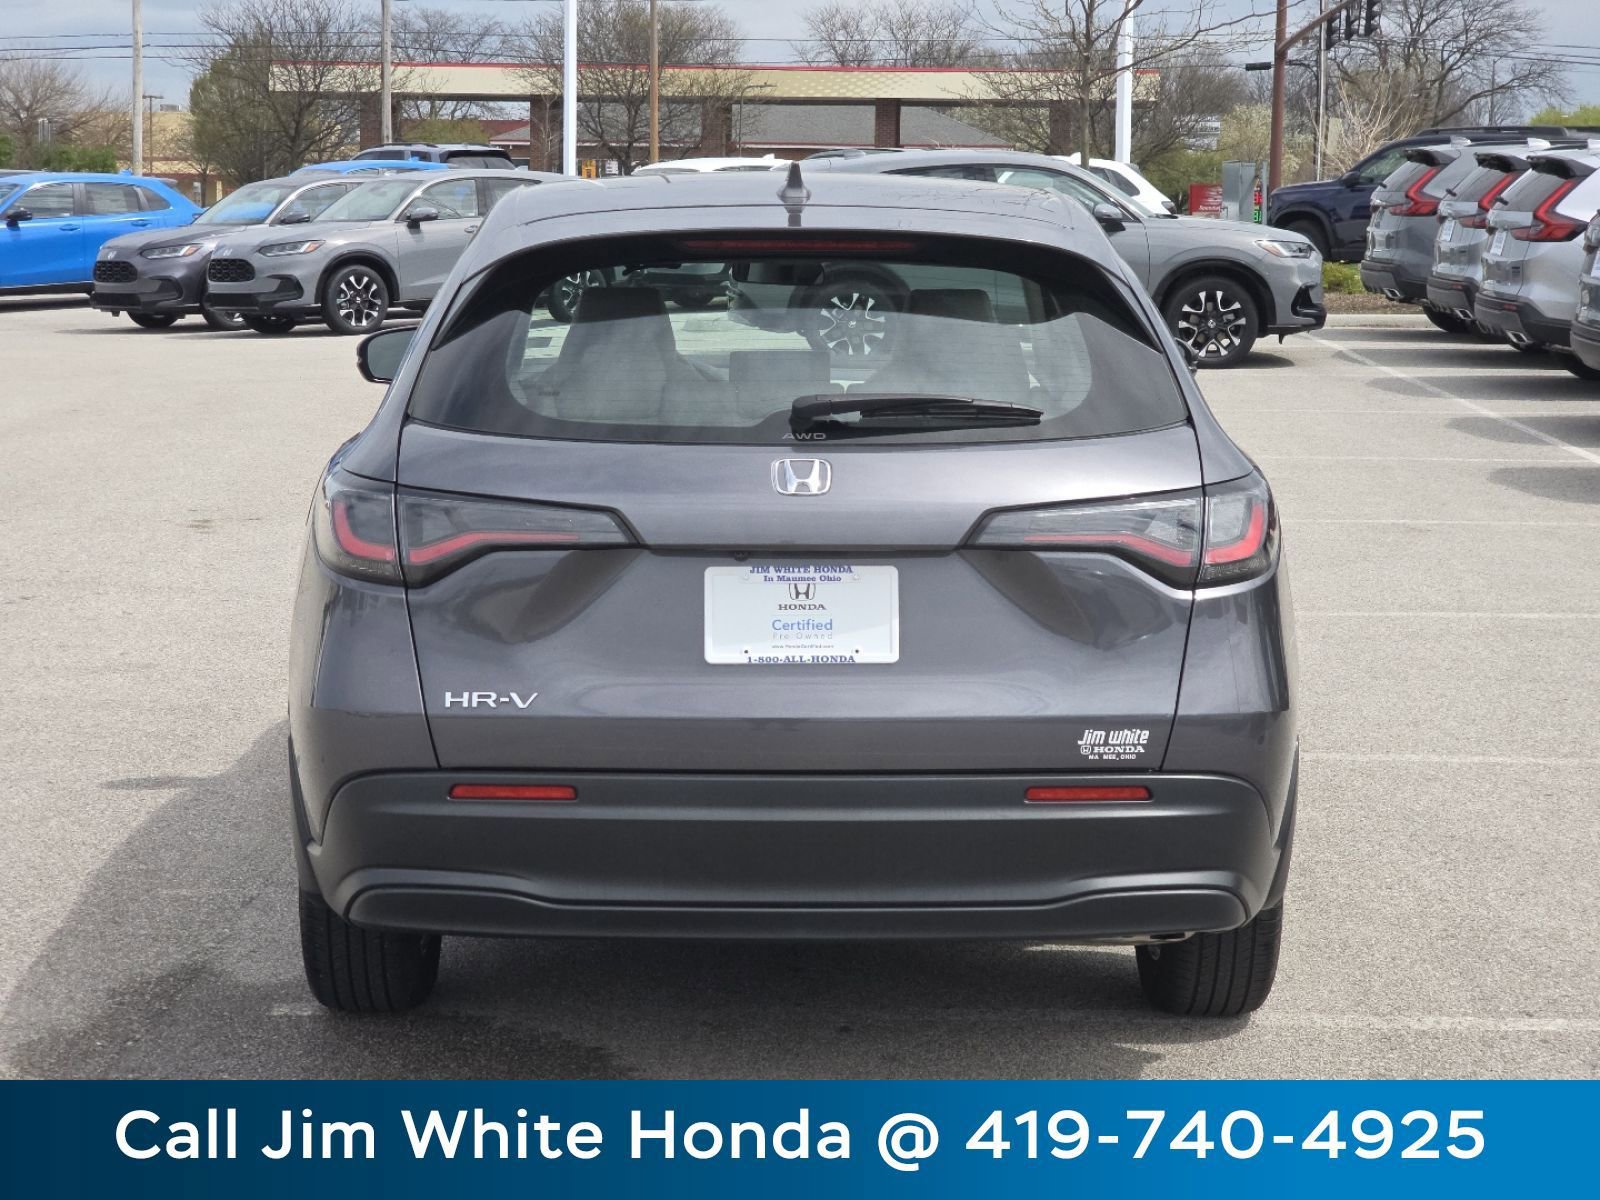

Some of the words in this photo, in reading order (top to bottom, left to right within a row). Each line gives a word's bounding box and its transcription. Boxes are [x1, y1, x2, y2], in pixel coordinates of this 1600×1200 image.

[782, 432, 827, 440] AWD
[750, 566, 770, 574] JIM
[775, 566, 811, 574] WHITE
[814, 566, 853, 574] HONDA
[772, 618, 833, 631] Certified
[747, 655, 856, 663] 1-800-ALL-HONDA
[444, 691, 539, 709] HR-V
[1077, 729, 1106, 745] Jim
[1092, 745, 1146, 753] HONDA
